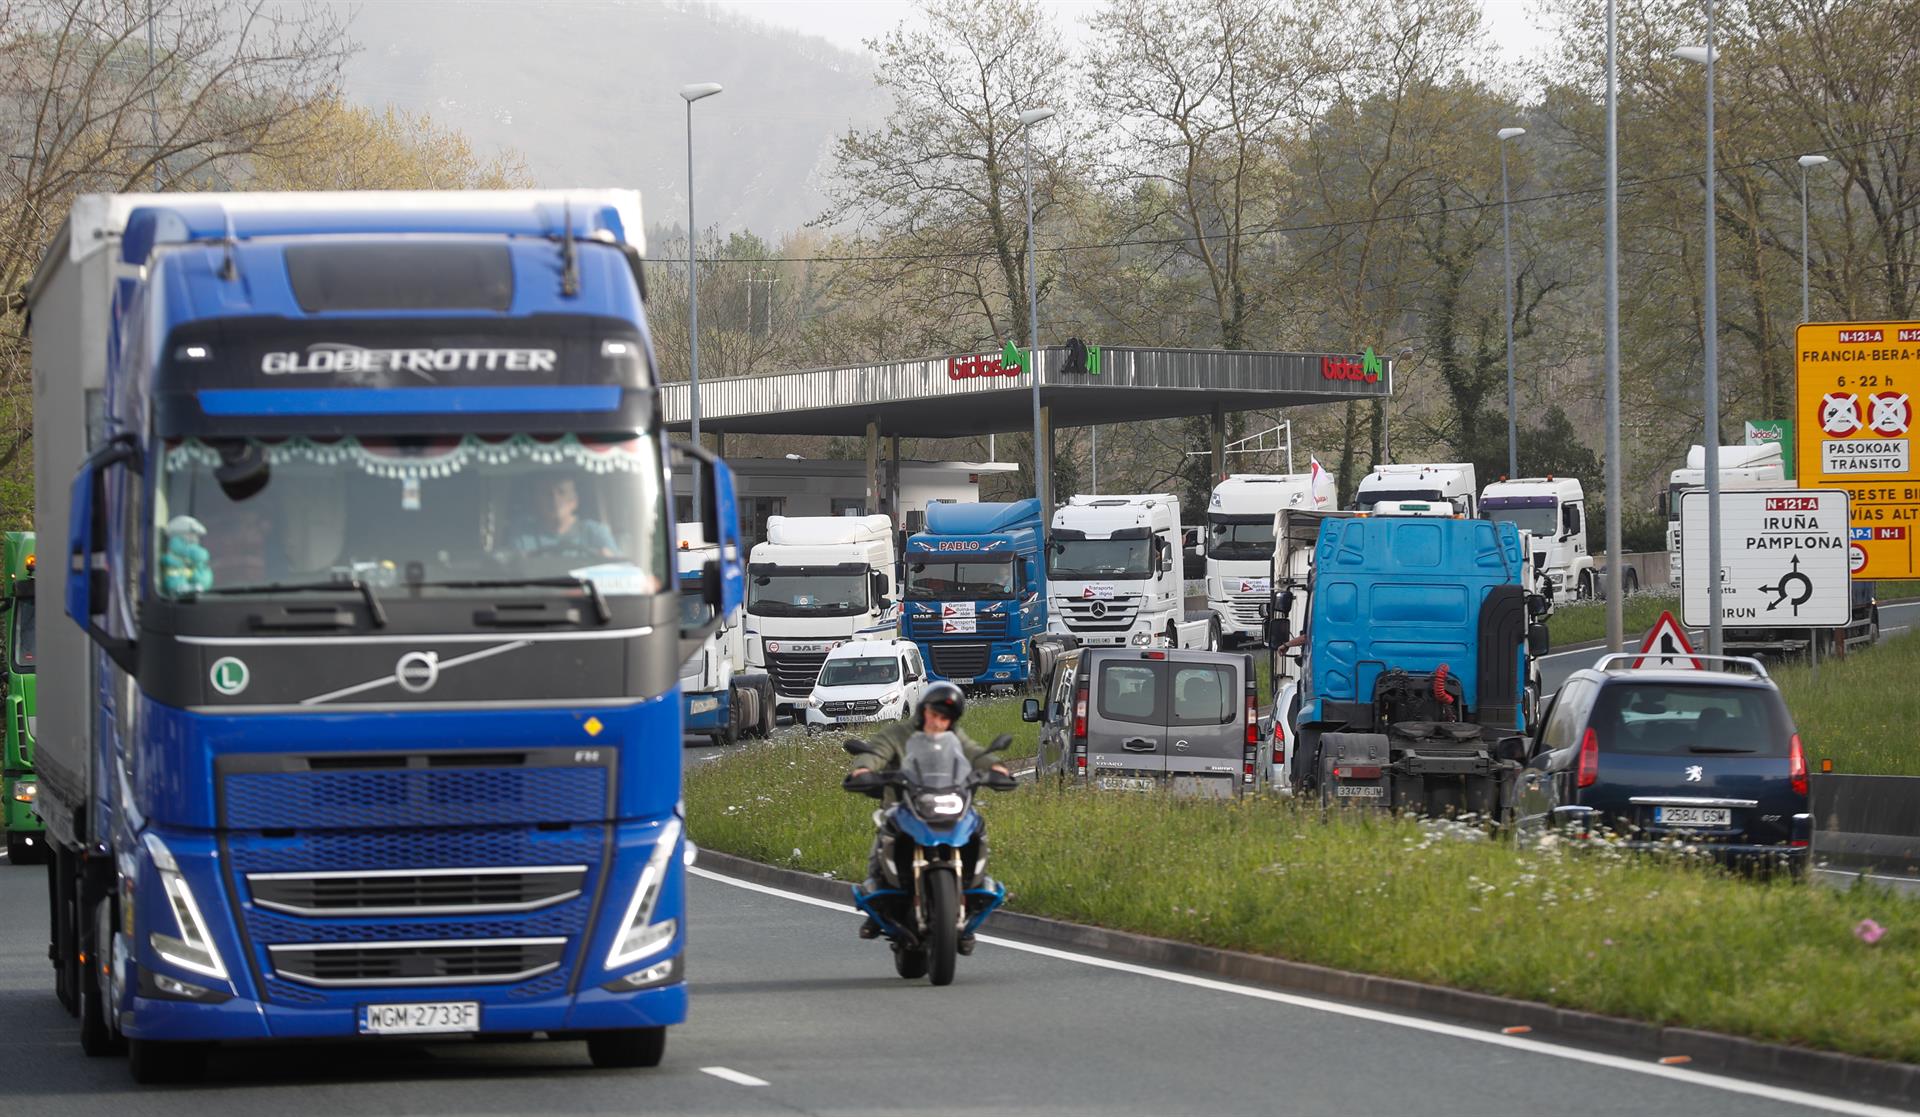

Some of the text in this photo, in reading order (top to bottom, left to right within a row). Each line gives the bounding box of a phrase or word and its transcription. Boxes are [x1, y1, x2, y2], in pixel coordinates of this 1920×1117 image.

[1840, 332, 1882, 341] N-121-A
[262, 348, 557, 375] GLOBETROTTER
[1837, 376, 1846, 387] 6
[1860, 376, 1878, 387] 22
[1885, 376, 1893, 386] h
[1829, 443, 1901, 454] PASOKOAK
[1831, 457, 1901, 470] TRÁNSITO
[1848, 489, 1896, 501] BESTE
[1767, 499, 1817, 509] N-121-A
[1850, 507, 1884, 520] VÍAS
[1763, 514, 1819, 530] IRUÑA
[1850, 529, 1872, 539] AP-1
[938, 541, 979, 550] PABLO
[1746, 536, 1843, 549] PAMPLONA
[1722, 607, 1755, 618] IRUN
[221, 664, 239, 688] L
[1339, 788, 1361, 796] 3347
[1667, 809, 1698, 822] 2584
[369, 1005, 475, 1027] WGM 2733F
